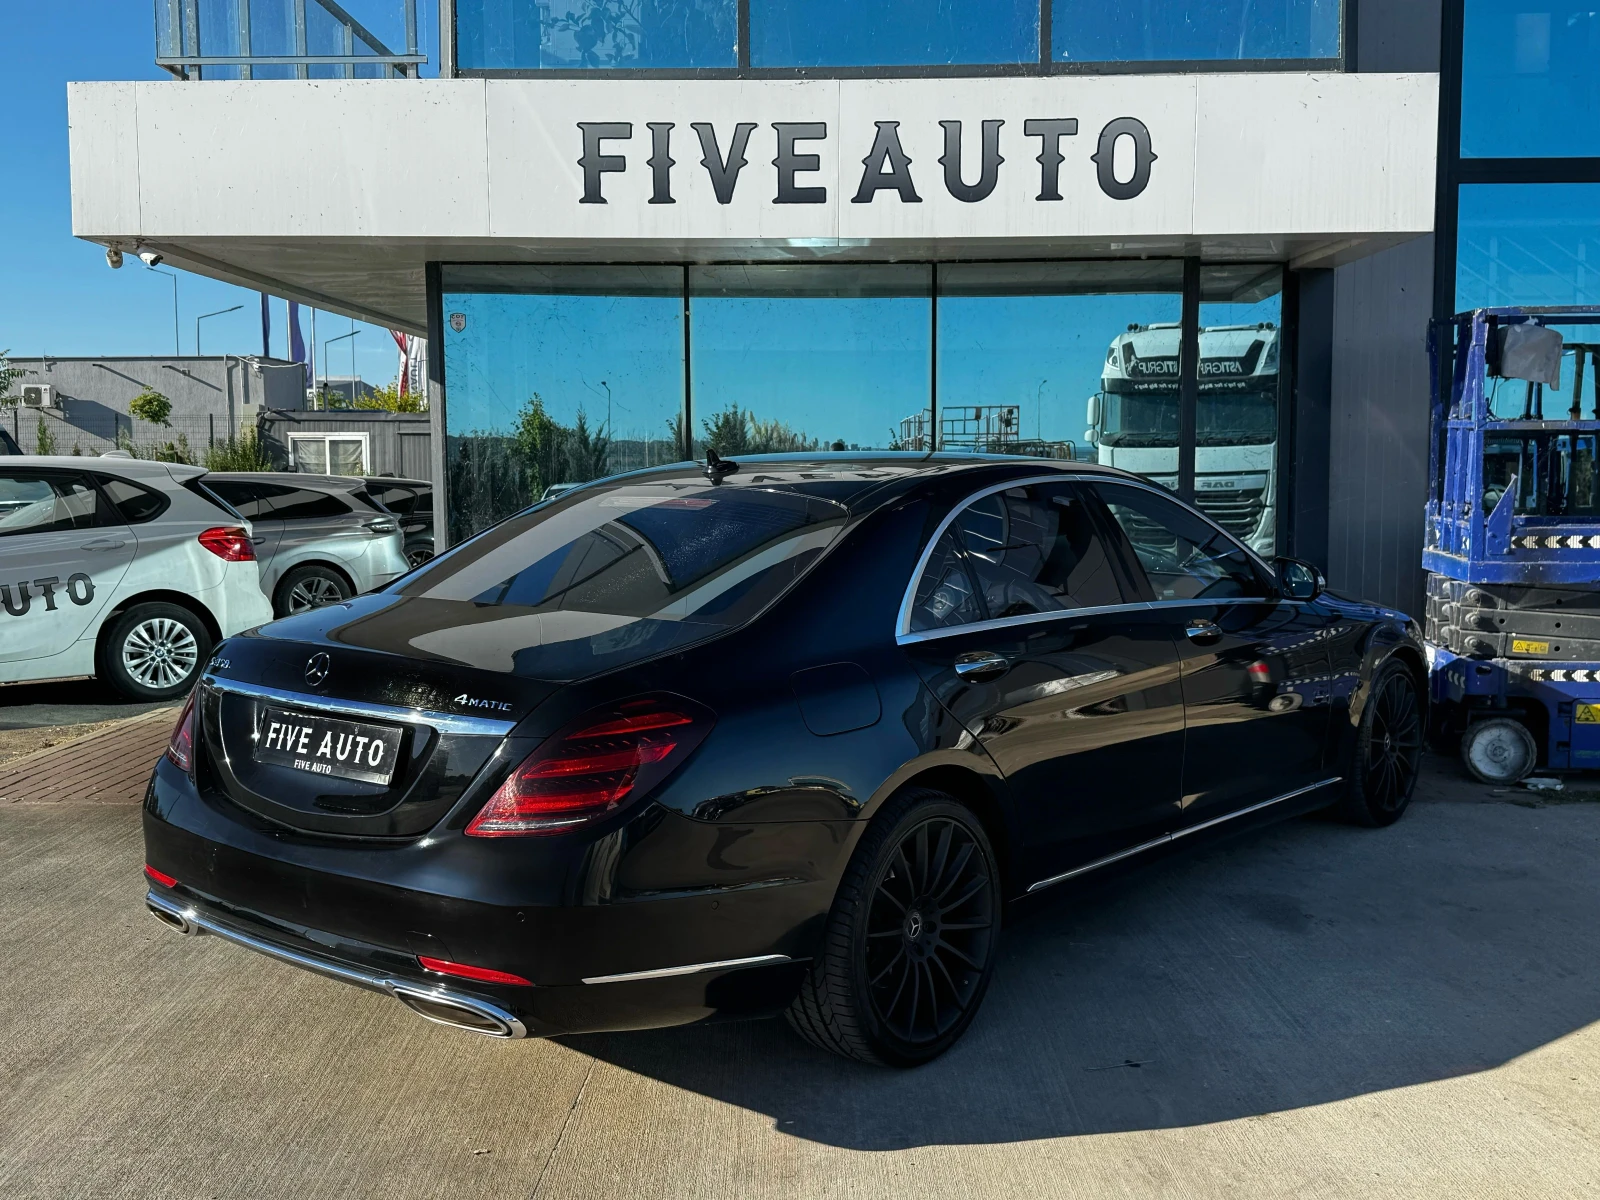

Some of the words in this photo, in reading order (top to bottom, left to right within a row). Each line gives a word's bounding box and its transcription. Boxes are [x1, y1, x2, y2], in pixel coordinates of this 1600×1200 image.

[454, 693, 513, 711] 4MATIC
[265, 722, 313, 754] FIVE
[316, 731, 384, 767] AUTO
[293, 759, 310, 770] FIVE
[311, 763, 332, 775] AUTO
